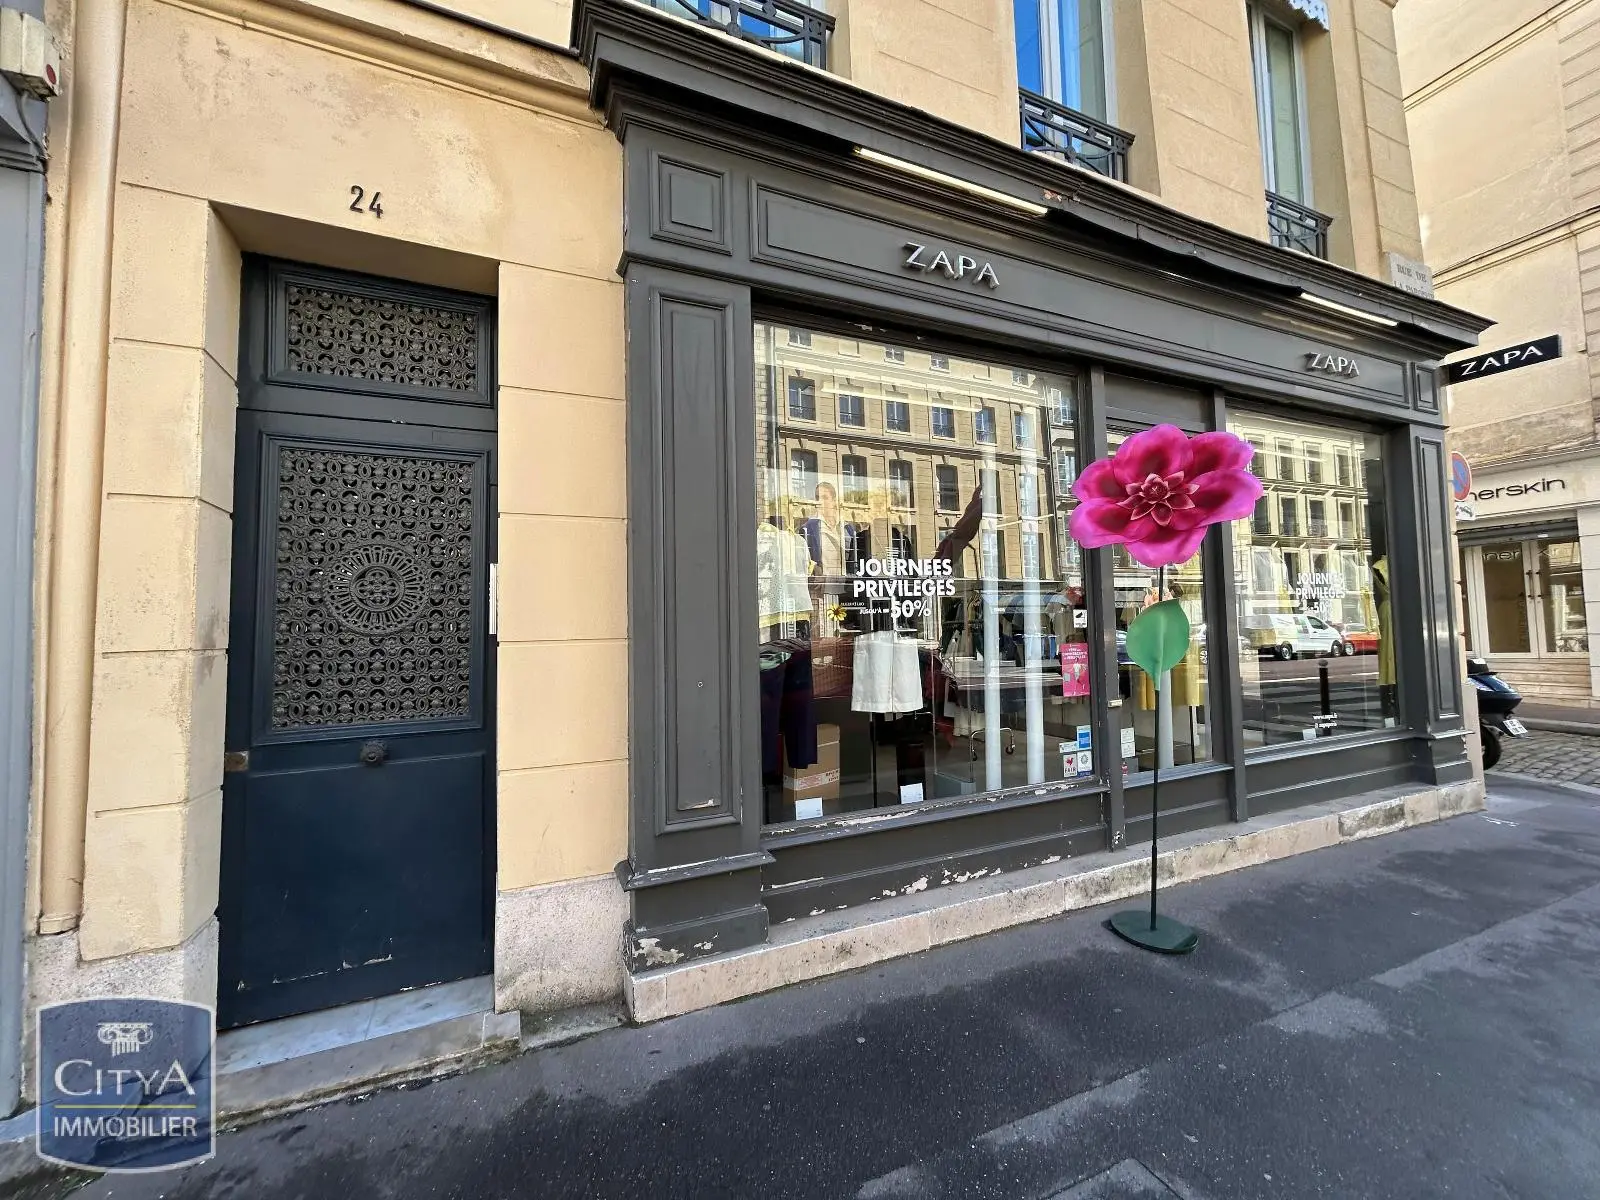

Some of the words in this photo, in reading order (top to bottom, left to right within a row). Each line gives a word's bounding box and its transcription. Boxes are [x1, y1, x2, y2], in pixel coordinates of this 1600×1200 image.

[350, 185, 383, 219] 24
[903, 241, 1000, 288] ZAPA
[1396, 263, 1412, 277] RUE
[1308, 352, 1360, 377] ZAPA
[1461, 345, 1544, 376] ZAPA
[856, 558, 952, 576] JOURNEES
[853, 578, 955, 598] PRIVILEGES
